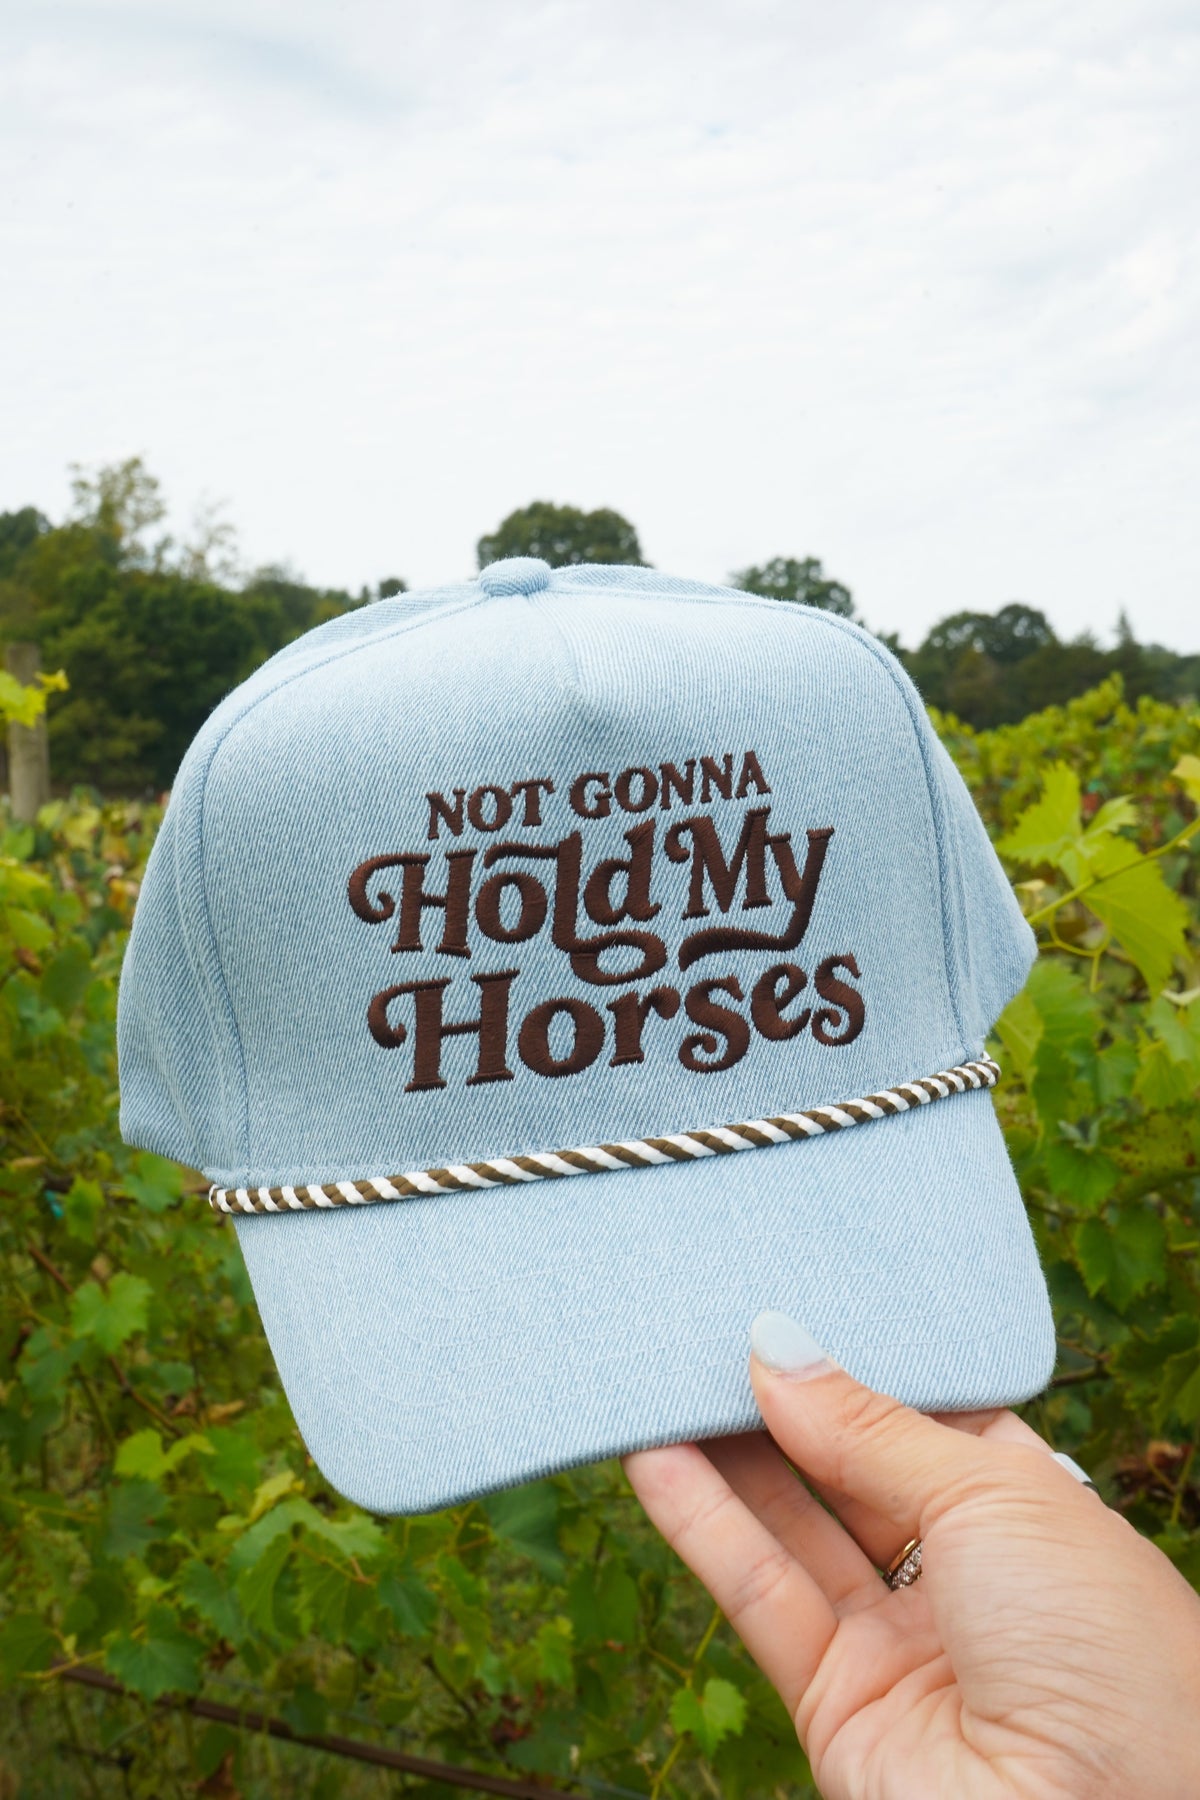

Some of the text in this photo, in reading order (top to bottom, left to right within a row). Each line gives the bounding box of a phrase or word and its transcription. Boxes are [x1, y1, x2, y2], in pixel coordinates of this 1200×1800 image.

[426, 751, 772, 840] NOT GONNA
[347, 805, 835, 987] Hold My
[367, 952, 866, 1094] Horses
